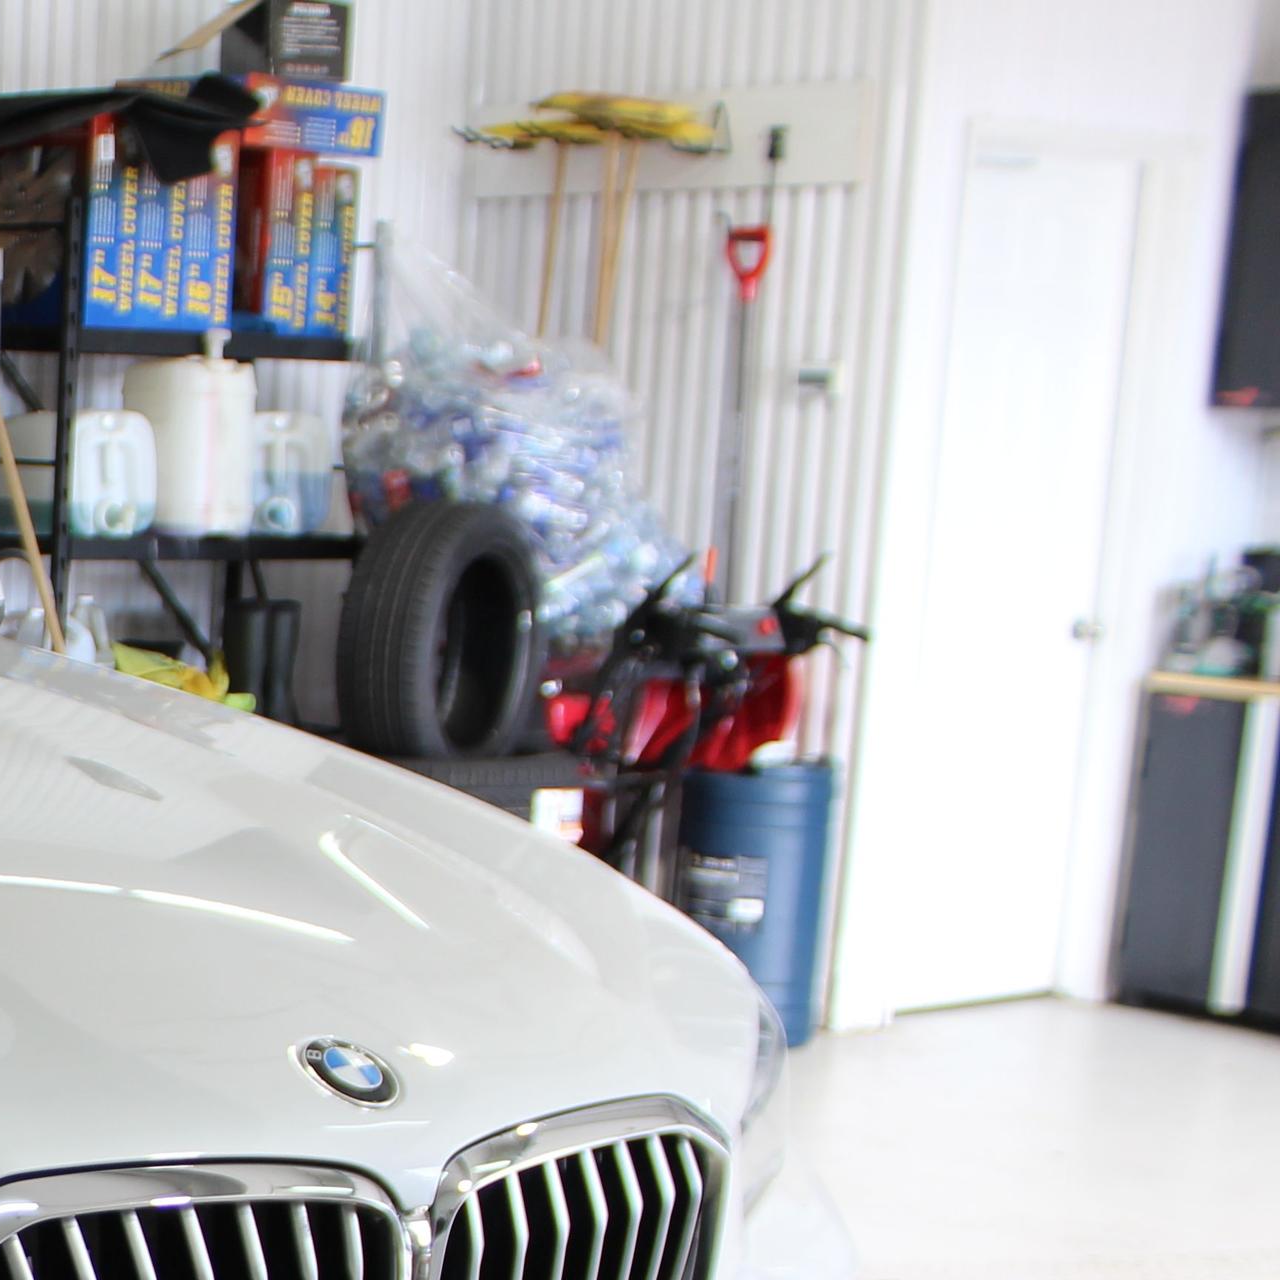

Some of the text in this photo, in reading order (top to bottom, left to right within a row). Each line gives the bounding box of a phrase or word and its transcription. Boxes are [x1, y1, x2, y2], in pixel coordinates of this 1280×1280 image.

[116, 166, 139, 312] WHEEL COVER
[163, 245, 182, 317] WHEEL
[213, 184, 234, 324] WHEEL COVER
[292, 192, 314, 329] WHEEL COVER
